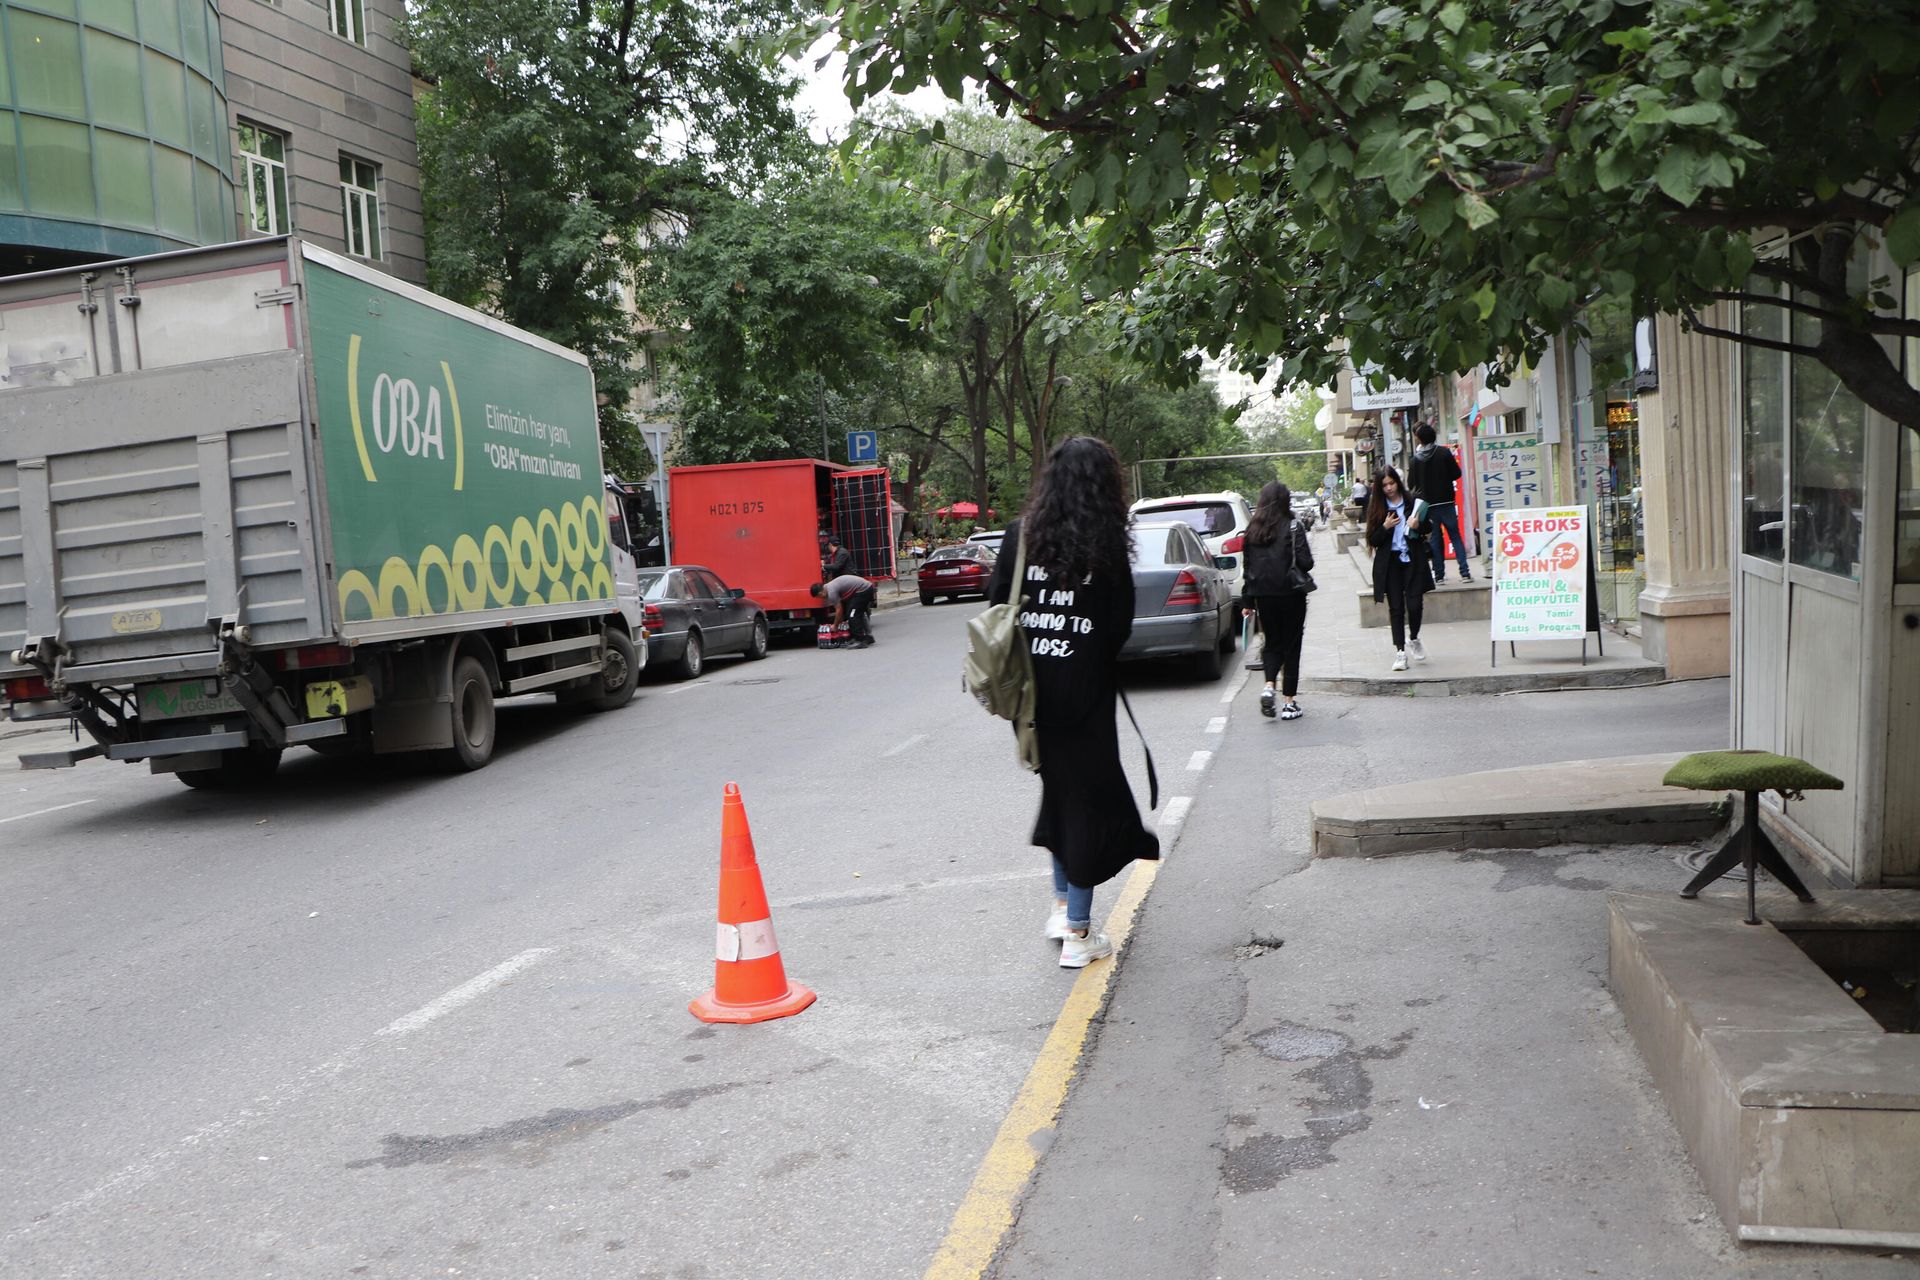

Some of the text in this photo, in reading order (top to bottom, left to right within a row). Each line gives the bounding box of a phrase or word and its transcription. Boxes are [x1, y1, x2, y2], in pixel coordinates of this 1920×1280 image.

[485, 404, 571, 448] Elimizin hər yanı,
[855, 434, 871, 458] P
[549, 453, 582, 481] ünvanı
[1510, 455, 1519, 467] 2
[743, 501, 765, 514] 875
[1499, 518, 1580, 534] KSEROKS
[1504, 538, 1514, 552] 1
[1509, 555, 1560, 574] PRİNT
[1499, 579, 1567, 592] TELEFON &
[1038, 589, 1075, 606] I AM
[1507, 594, 1580, 606] KOMPYUTER
[118, 612, 152, 625] ATEK
[1546, 609, 1574, 618] Təmir
[1069, 615, 1094, 634] TO
